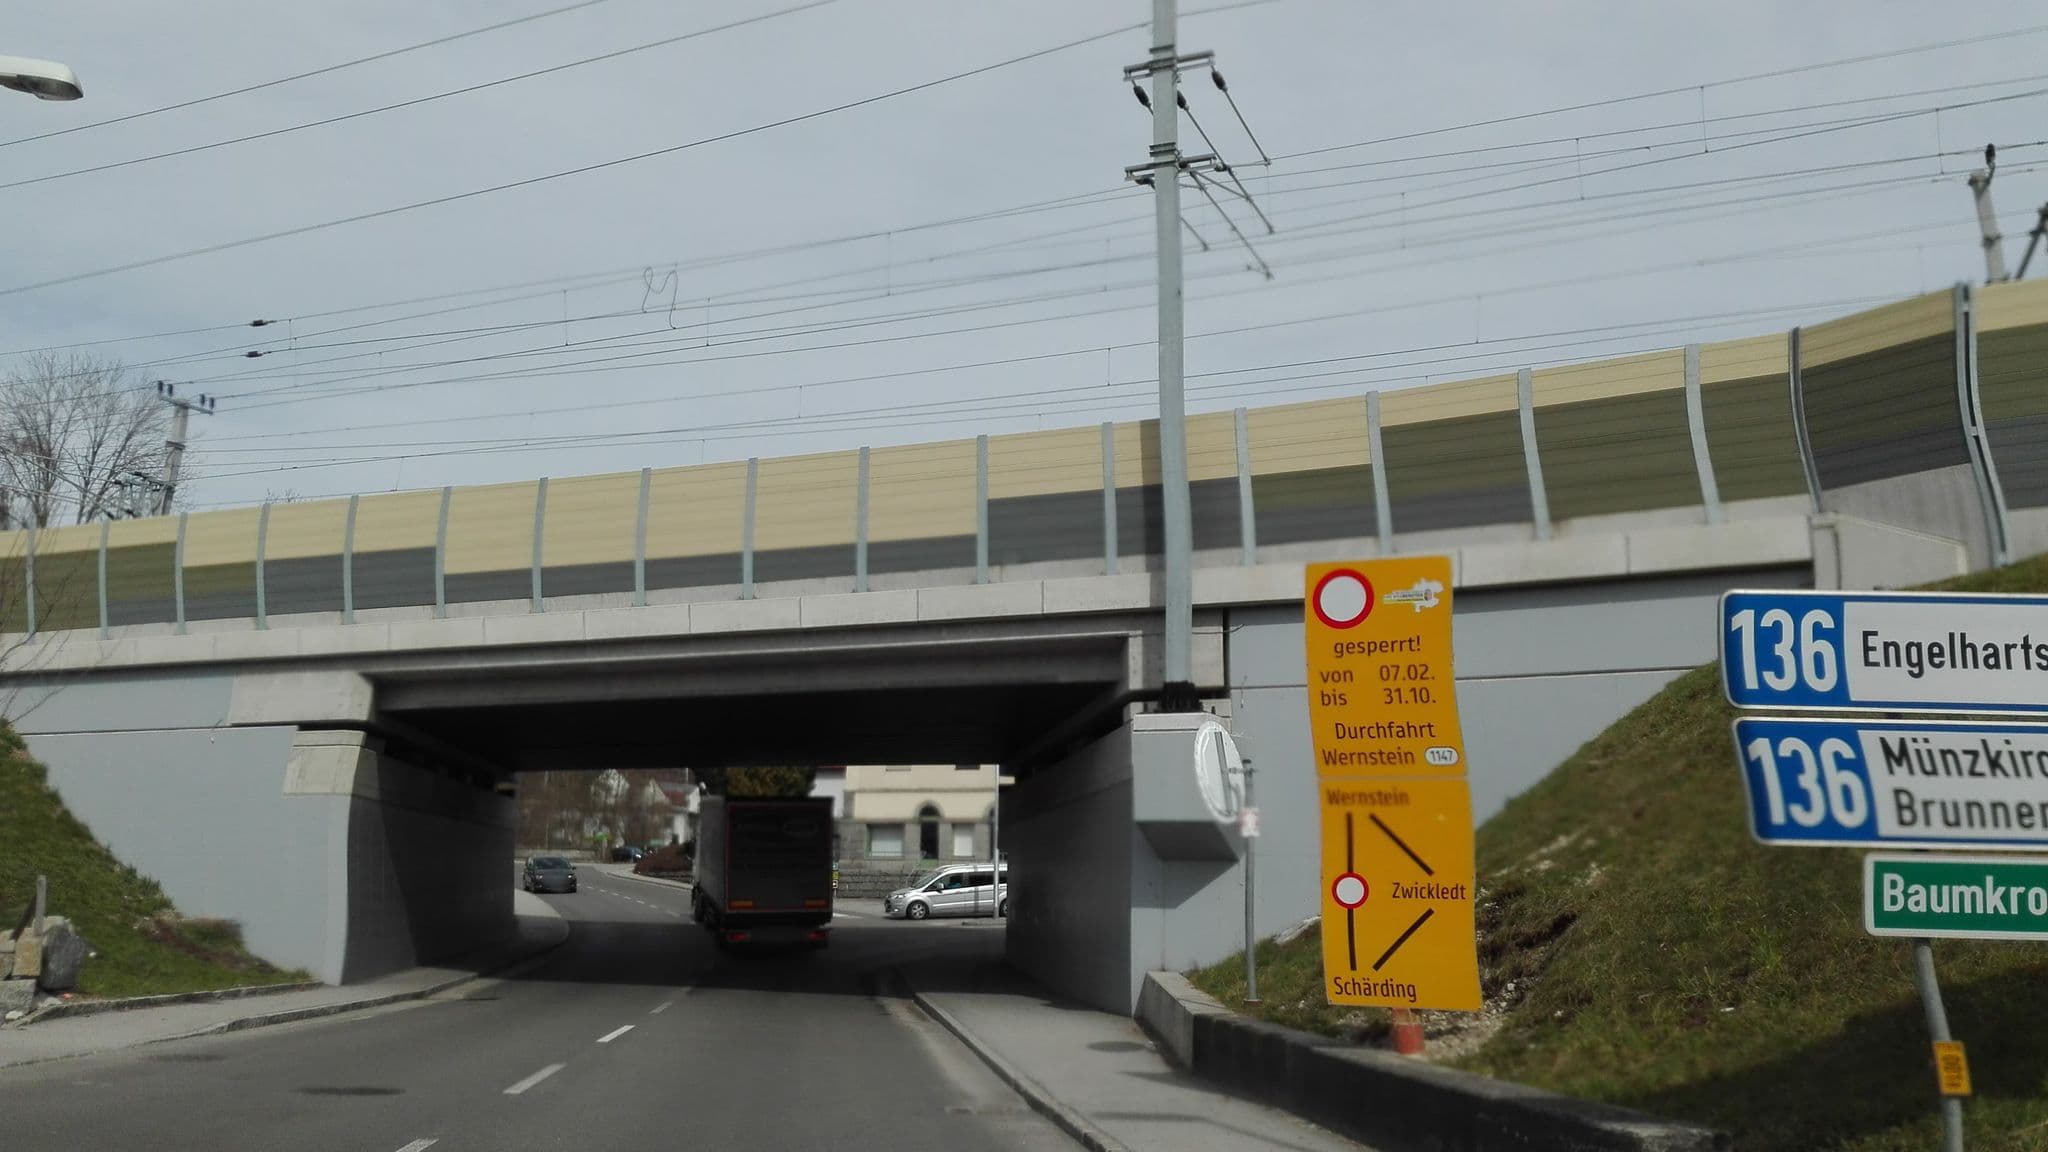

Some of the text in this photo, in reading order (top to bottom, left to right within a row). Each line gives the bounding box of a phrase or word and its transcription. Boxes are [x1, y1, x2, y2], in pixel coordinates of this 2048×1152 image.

[1333, 635, 1421, 658] gesperrt!
[1731, 608, 2048, 693] 136 Engelharts
[1320, 664, 1436, 683] von 07.02.
[1320, 687, 1437, 707] bis 31.10.
[1335, 721, 1436, 740] Durchfahrt
[1322, 747, 1453, 766] Wernstein 1147
[1747, 736, 1869, 829] 136
[1326, 787, 1410, 806] Wernstein
[1392, 881, 1467, 900] Zwickledt
[1883, 873, 2048, 916] Baumkro
[1333, 976, 1417, 1003] Schärding
